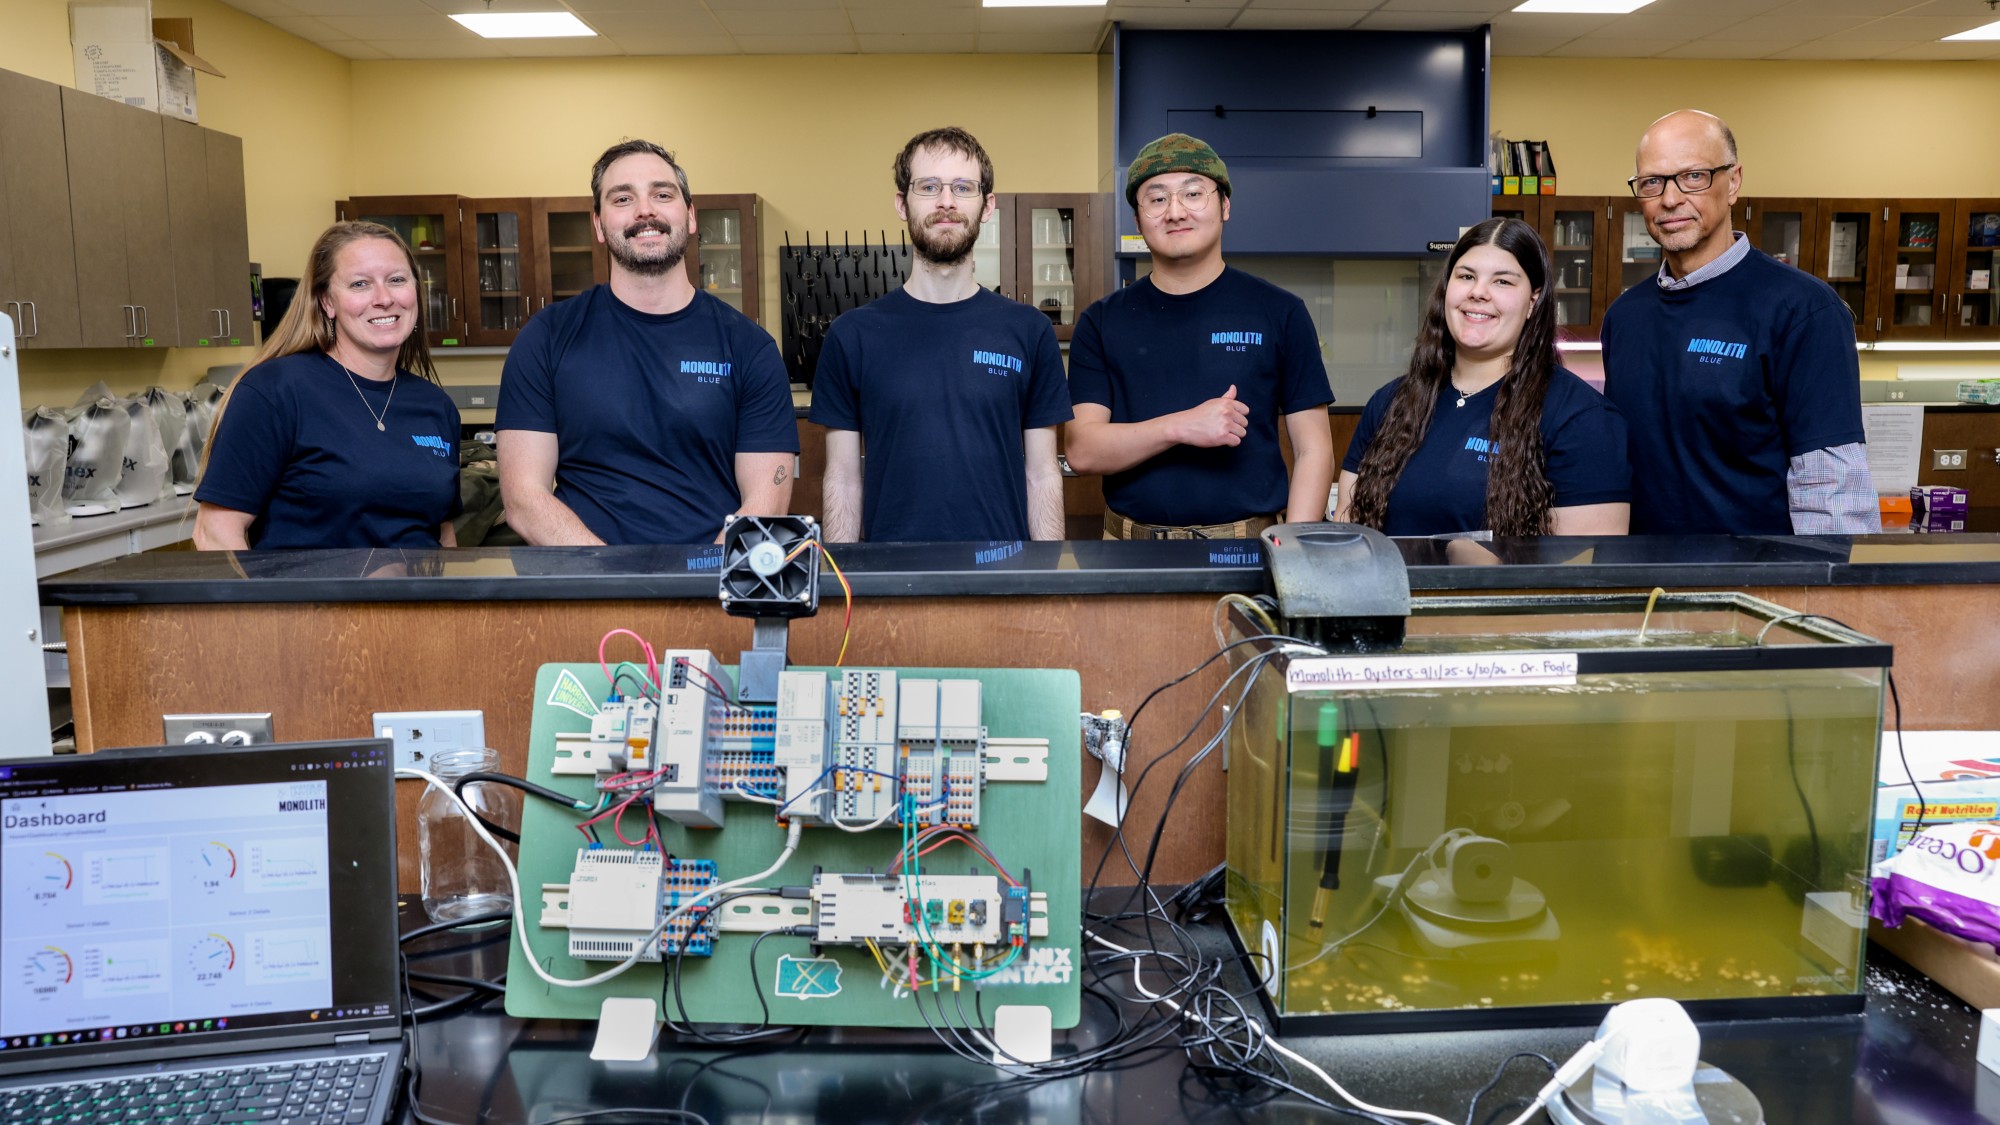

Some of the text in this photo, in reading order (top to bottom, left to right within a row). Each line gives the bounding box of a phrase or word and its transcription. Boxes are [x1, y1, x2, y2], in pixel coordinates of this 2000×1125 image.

[1211, 332, 1262, 345] MONOLITH
[1687, 338, 1747, 359] MONOLITH
[973, 350, 1022, 373] MONOLITH
[1699, 355, 1722, 365] BLUE
[988, 367, 1008, 377] BLUE
[697, 376, 721, 384] BLUE
[279, 798, 326, 812] MONOLITH
[1906, 804, 1993, 815] Reef Nutrition
[5, 810, 107, 829] Dashboard
